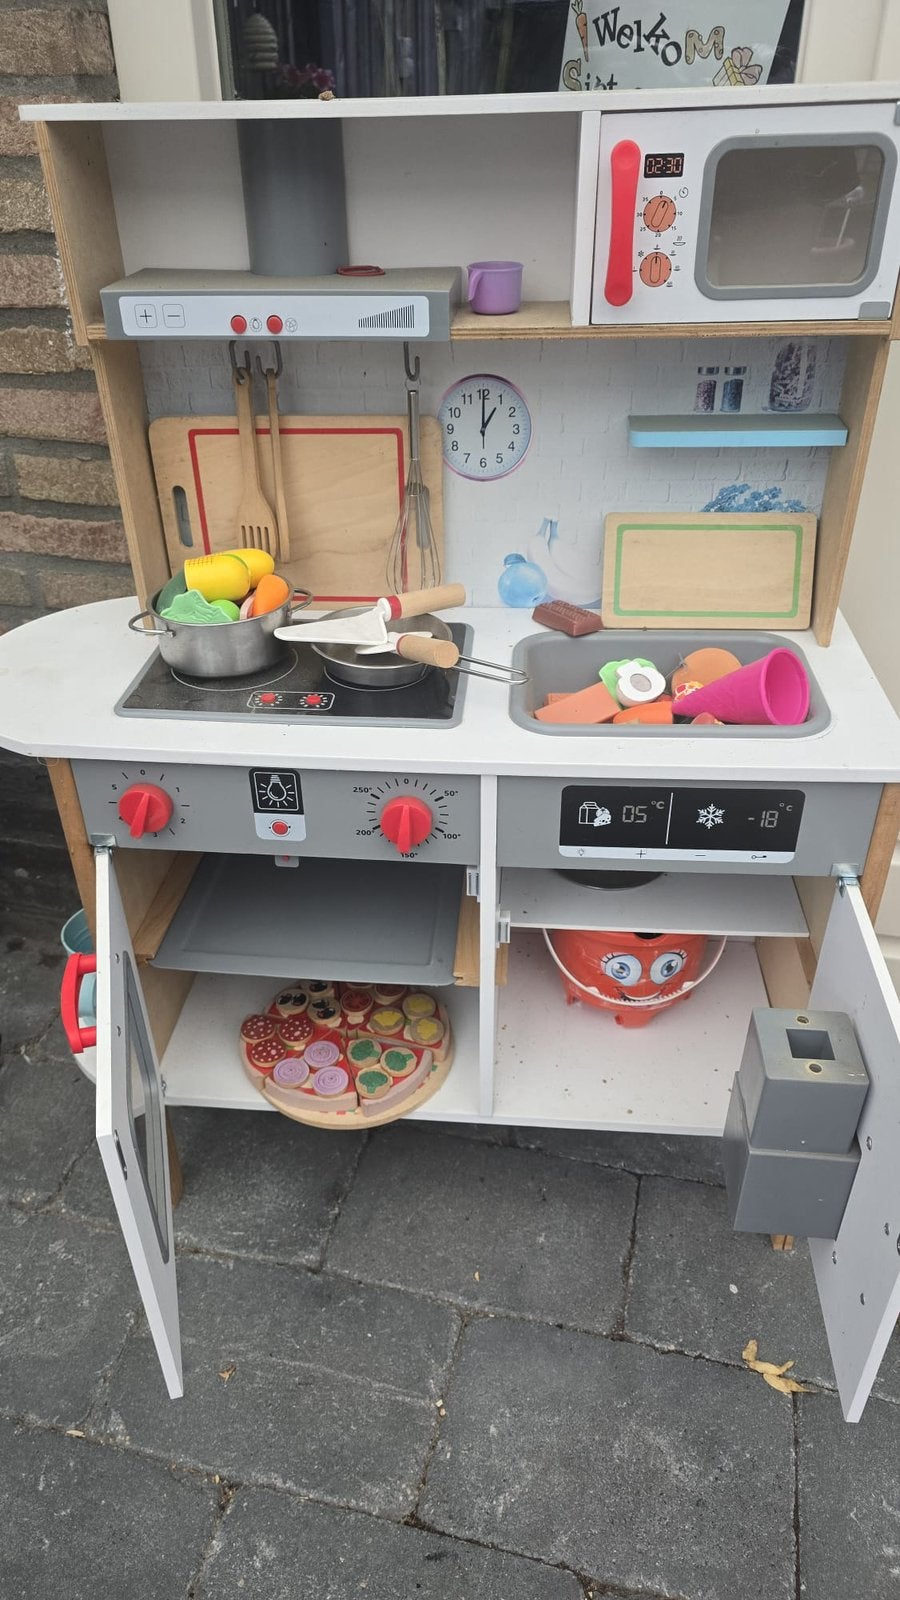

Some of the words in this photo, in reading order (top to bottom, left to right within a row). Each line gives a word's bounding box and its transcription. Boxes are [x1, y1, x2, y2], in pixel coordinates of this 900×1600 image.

[646, 157, 682, 174] 02:30
[461, 393, 472, 405] 11
[476, 388, 490, 400] 12
[497, 393, 503, 405] 1
[448, 406, 461, 418] 10
[508, 406, 516, 418] 2
[446, 423, 454, 435] 9
[512, 423, 520, 435] 3
[451, 440, 459, 451] 8
[507, 441, 515, 452] 4
[463, 452, 471, 463] 7
[479, 457, 487, 468] 6
[495, 452, 503, 464] 5
[621, 805, 648, 824] 05
